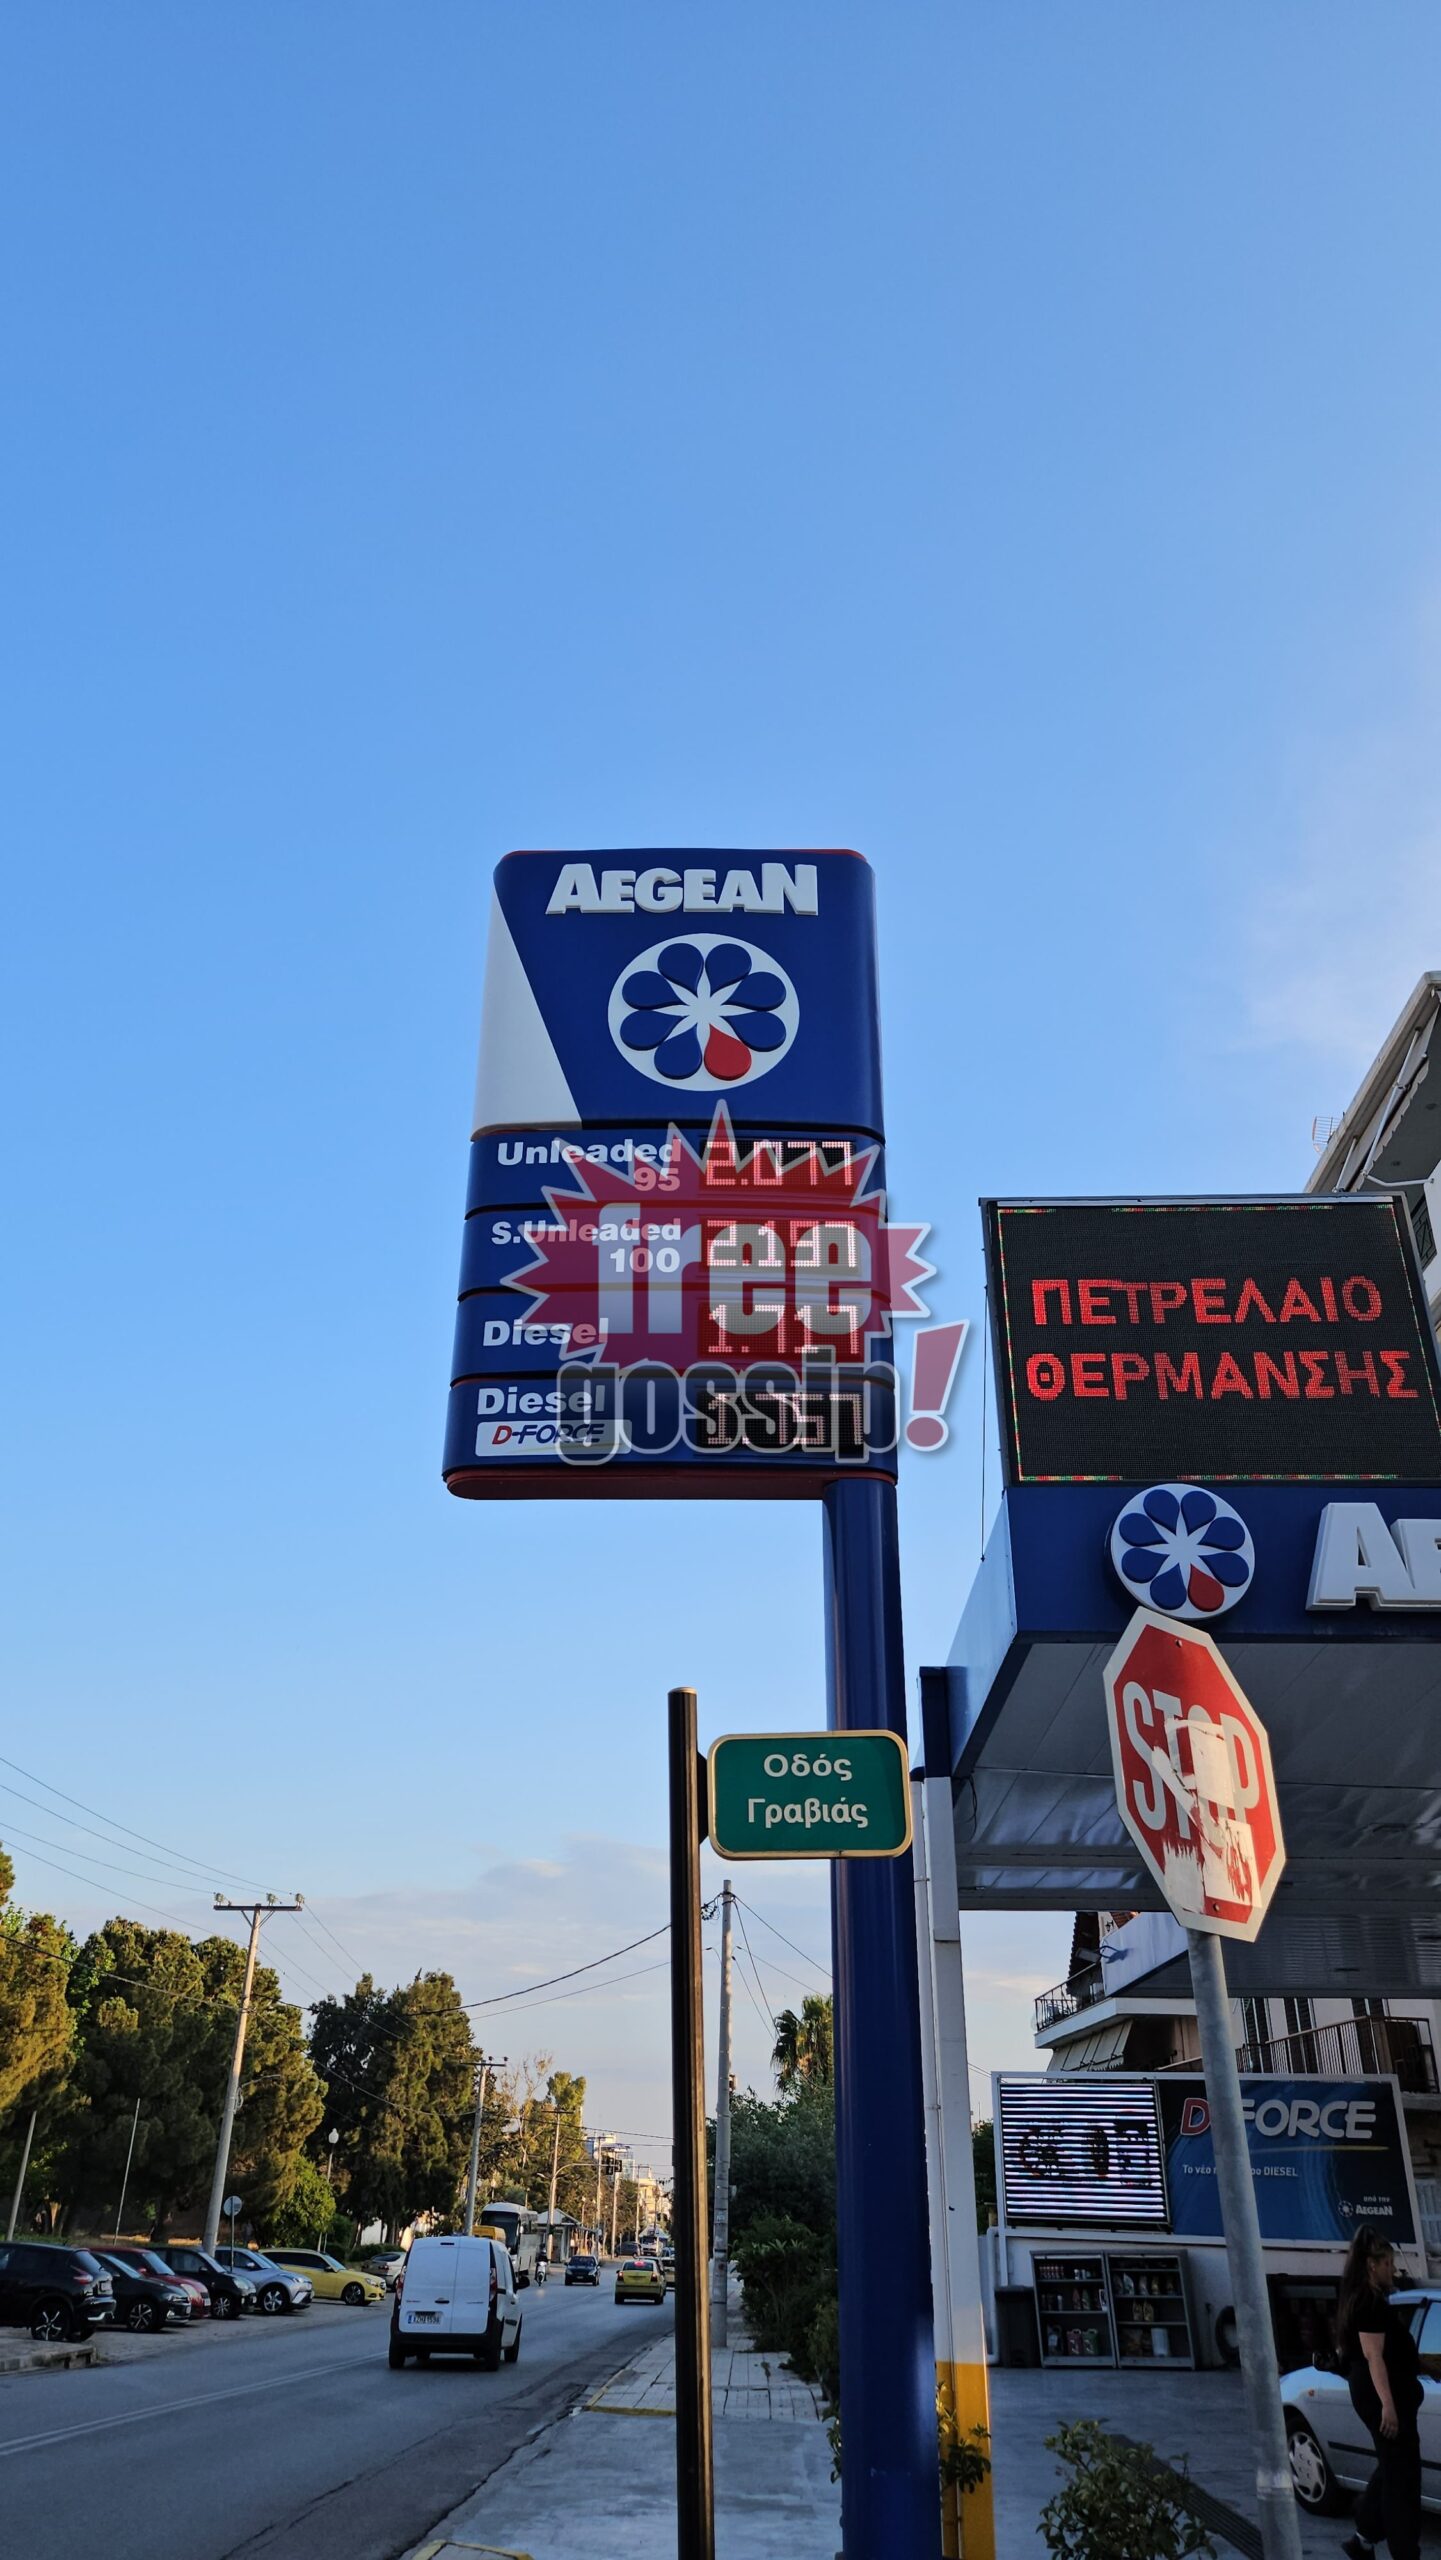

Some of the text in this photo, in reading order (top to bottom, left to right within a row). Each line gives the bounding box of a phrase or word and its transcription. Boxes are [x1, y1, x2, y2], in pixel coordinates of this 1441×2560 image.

[545, 863, 819, 916] AEGEAN
[498, 1139, 852, 1185] Unleaded 2.077
[634, 1167, 680, 1191] 95
[491, 1218, 857, 1268] S.Unleaded 2.197
[610, 1247, 680, 1273] 100
[1031, 1276, 1383, 1325] ΠΕΤΡΕΛΑΙΟ
[483, 1304, 859, 1354] Diesel 1.717
[1026, 1351, 1418, 1400] ΘΕΡΜΑΝΣΗΣ
[477, 1385, 864, 1445] Diesel 1.757
[492, 1424, 605, 1445] D-FORCE
[764, 1754, 852, 1781] Οδός
[748, 1797, 868, 1828] Γραβιάς
[1264, 2166, 1299, 2177] DIESEL
